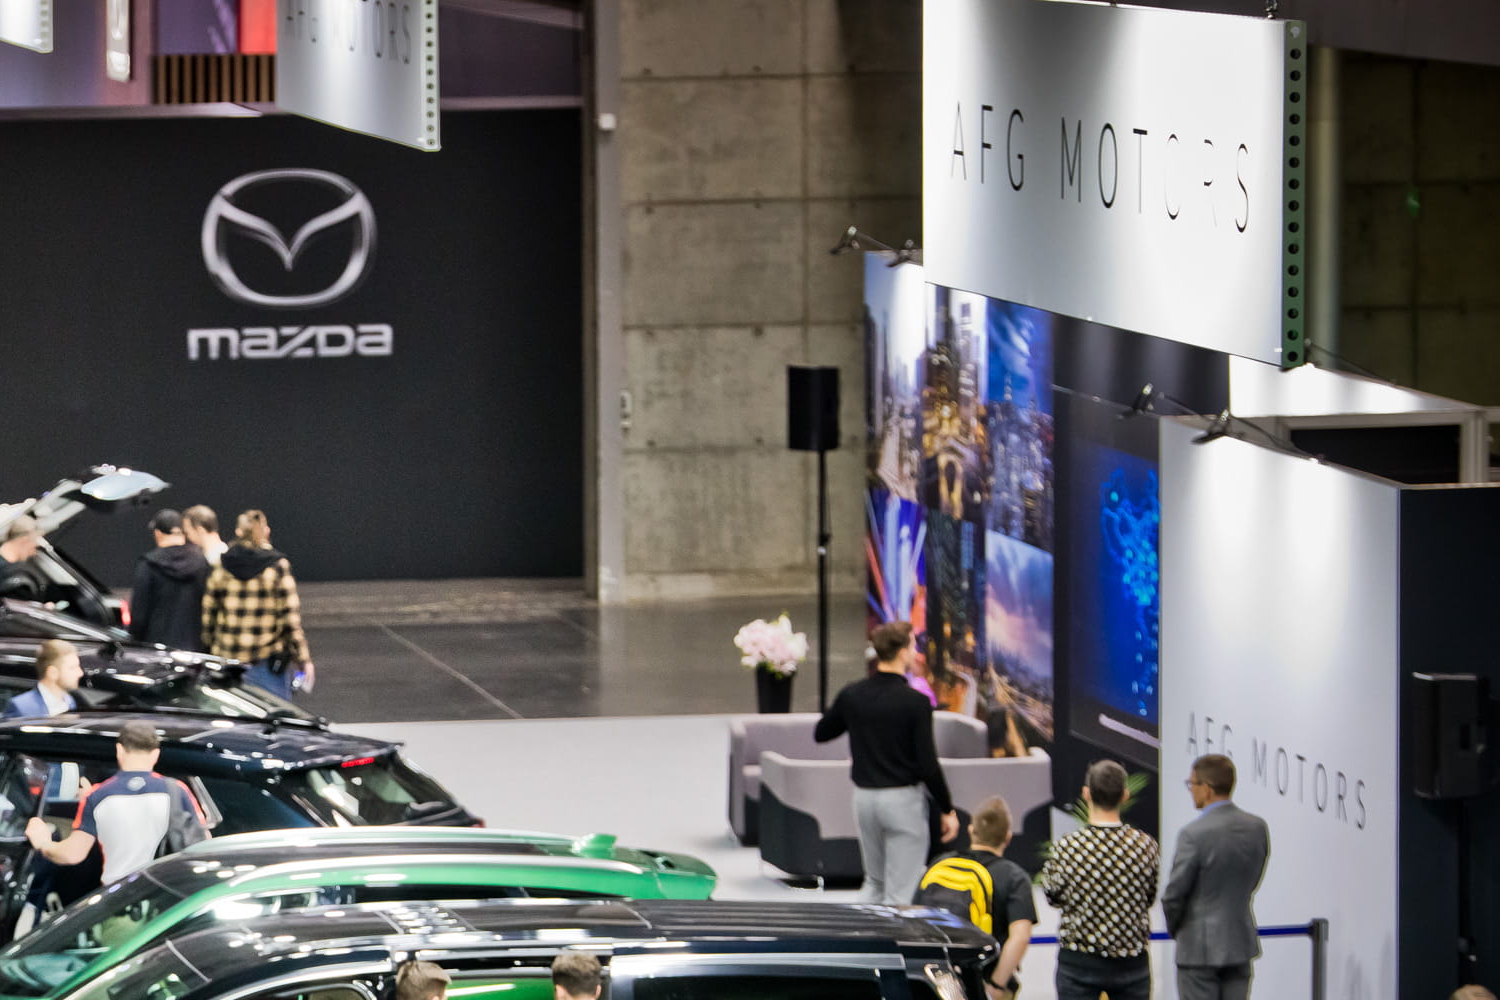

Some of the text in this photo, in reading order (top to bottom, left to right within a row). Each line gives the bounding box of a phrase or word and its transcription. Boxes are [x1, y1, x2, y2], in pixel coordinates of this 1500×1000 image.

[951, 101, 1249, 233] AFG MOTORS
[1253, 736, 1366, 830] MOTORS
